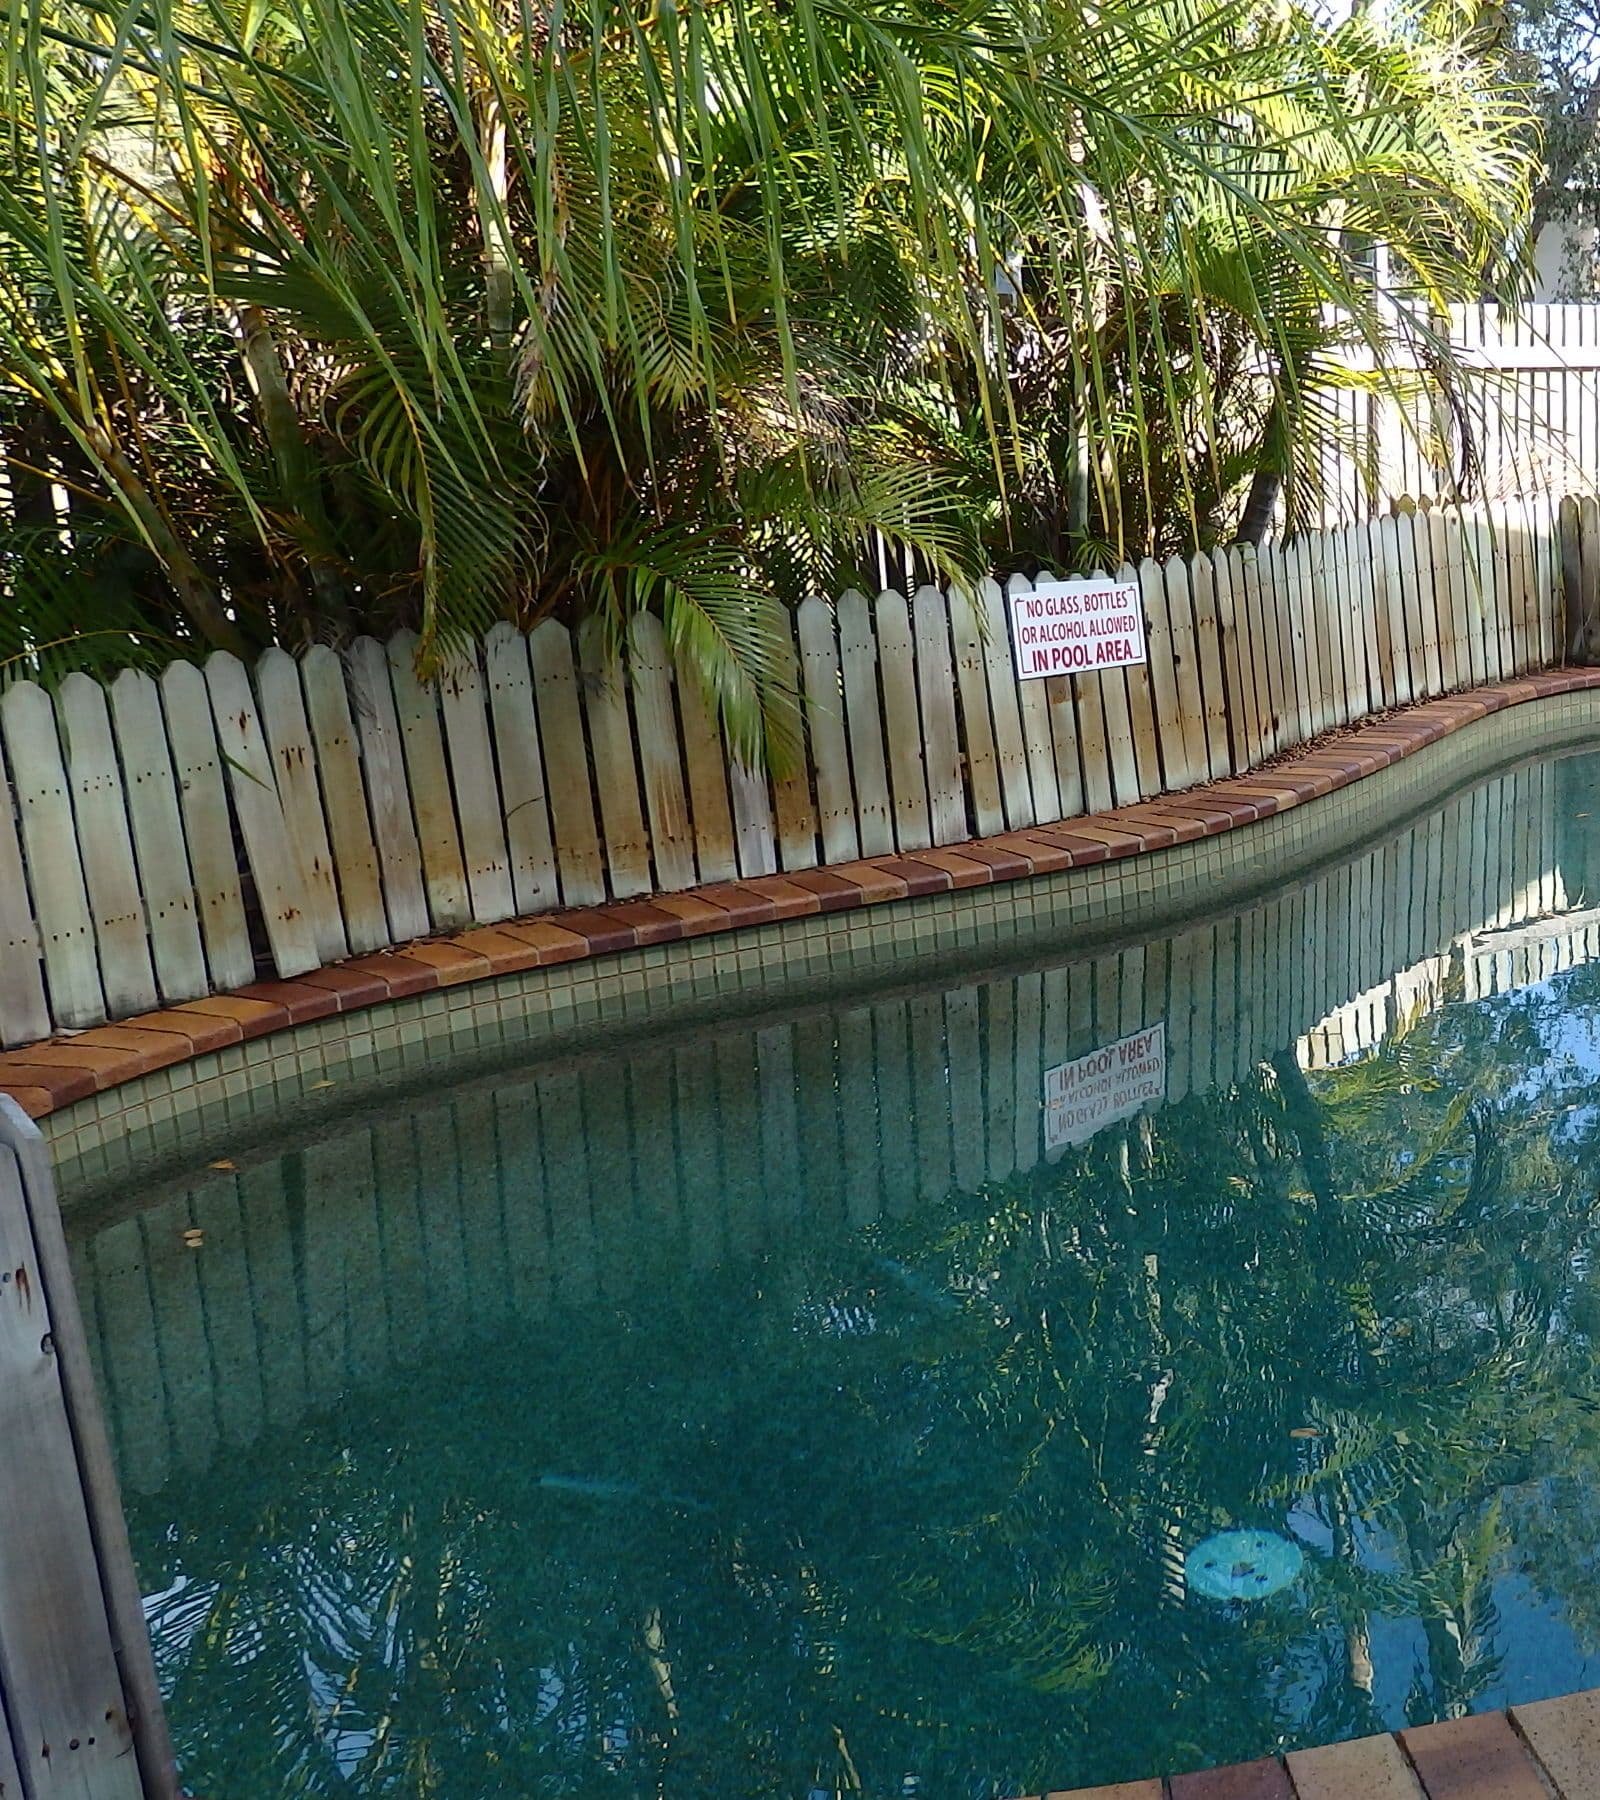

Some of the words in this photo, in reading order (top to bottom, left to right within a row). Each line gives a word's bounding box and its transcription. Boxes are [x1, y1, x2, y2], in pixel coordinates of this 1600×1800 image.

[1026, 599, 1043, 618] NO
[1046, 595, 1083, 616] GLASS,
[1084, 590, 1128, 612] BOTTLES
[1022, 626, 1037, 645] OR
[1040, 621, 1087, 642] ALCOHOL
[1089, 615, 1136, 637] ALLOWED
[1032, 649, 1048, 672] IN
[1052, 644, 1092, 670] POOL
[1096, 639, 1133, 664] AREA
